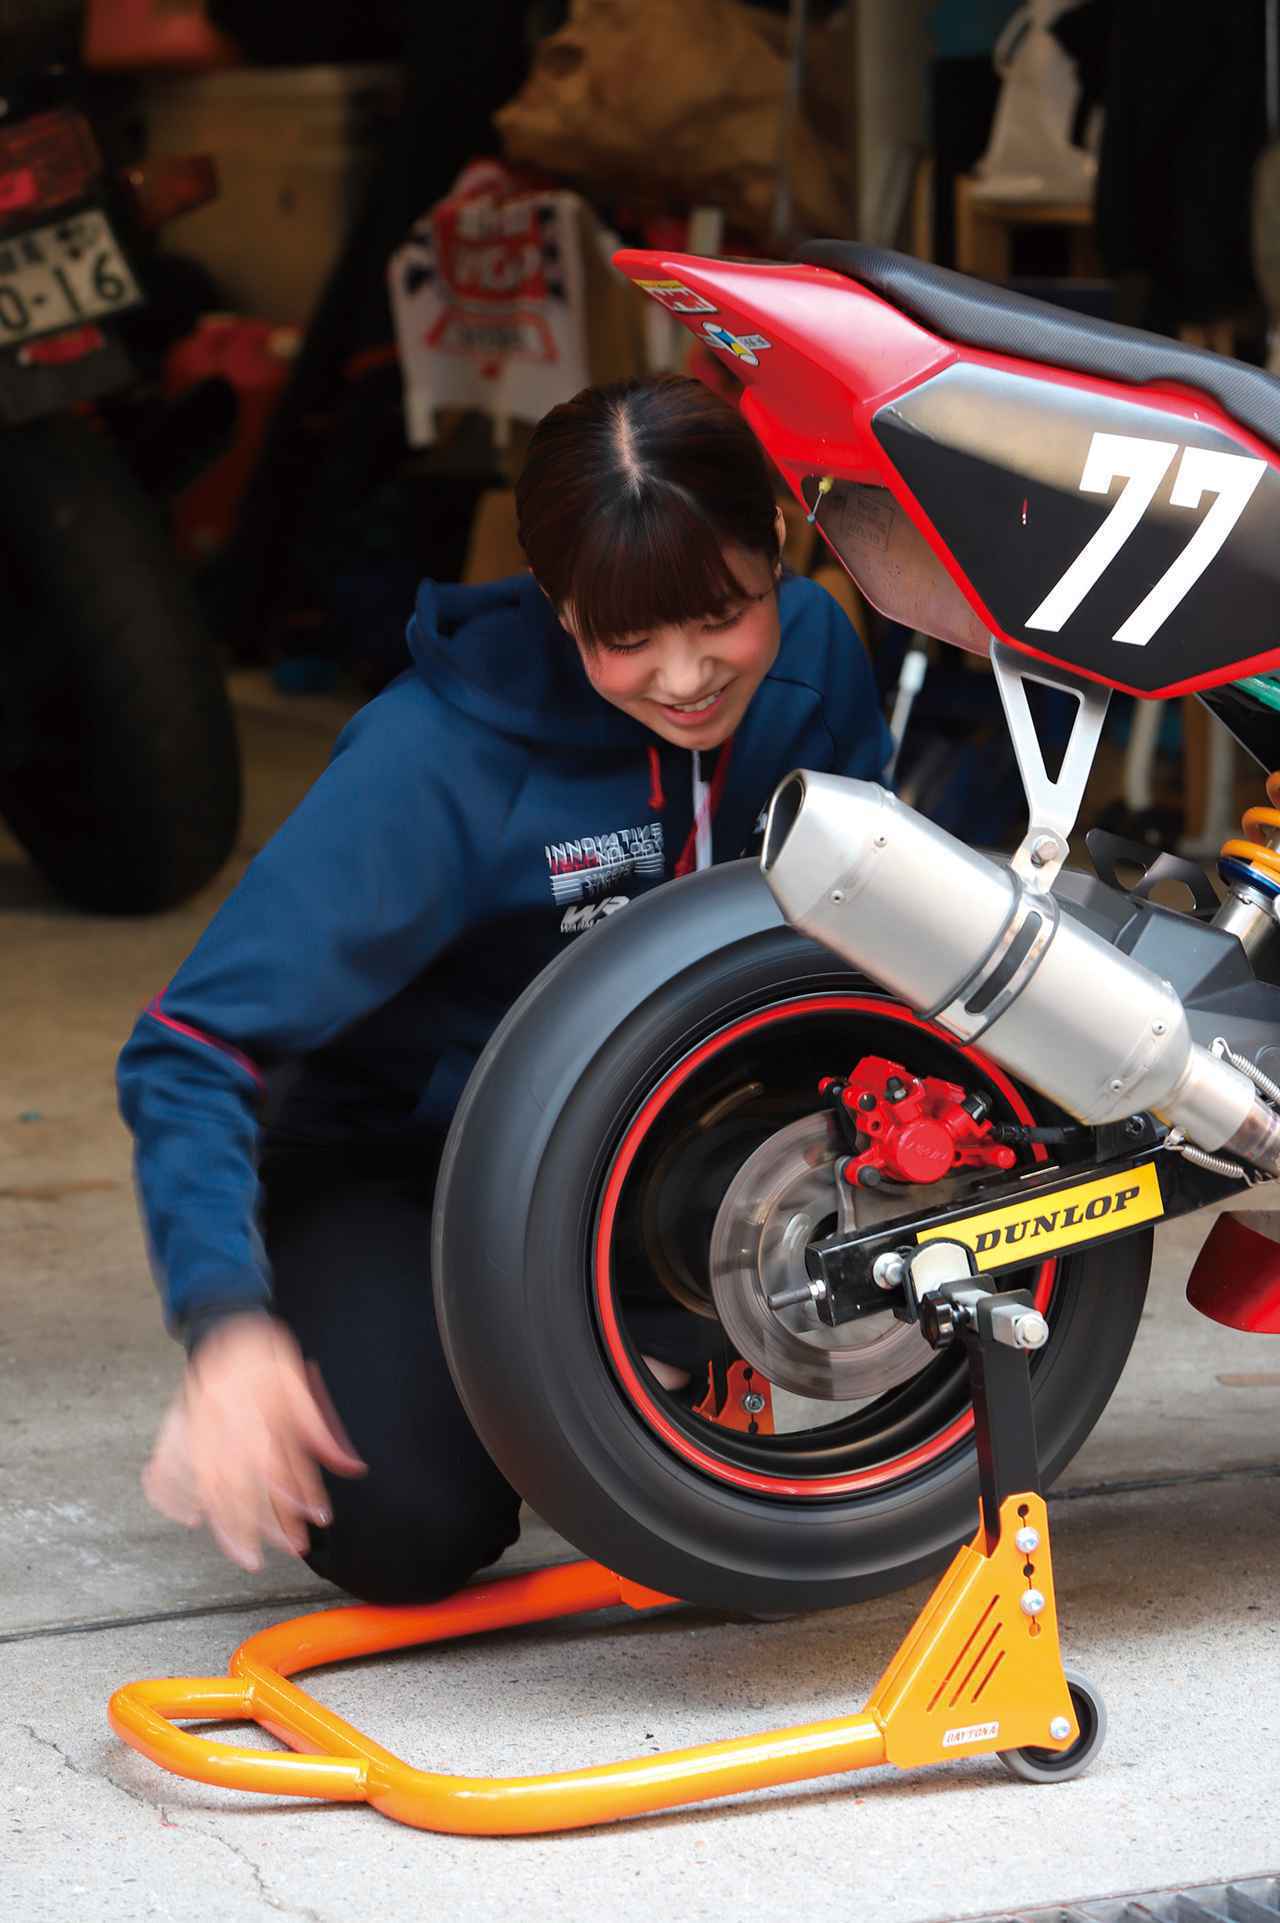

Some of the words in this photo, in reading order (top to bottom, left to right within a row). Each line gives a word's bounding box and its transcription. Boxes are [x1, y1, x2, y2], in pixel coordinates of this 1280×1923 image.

[1024, 432, 1268, 646] 77
[545, 822, 663, 869] INNOVATIVE
[974, 1186, 1140, 1253] DUNLOP
